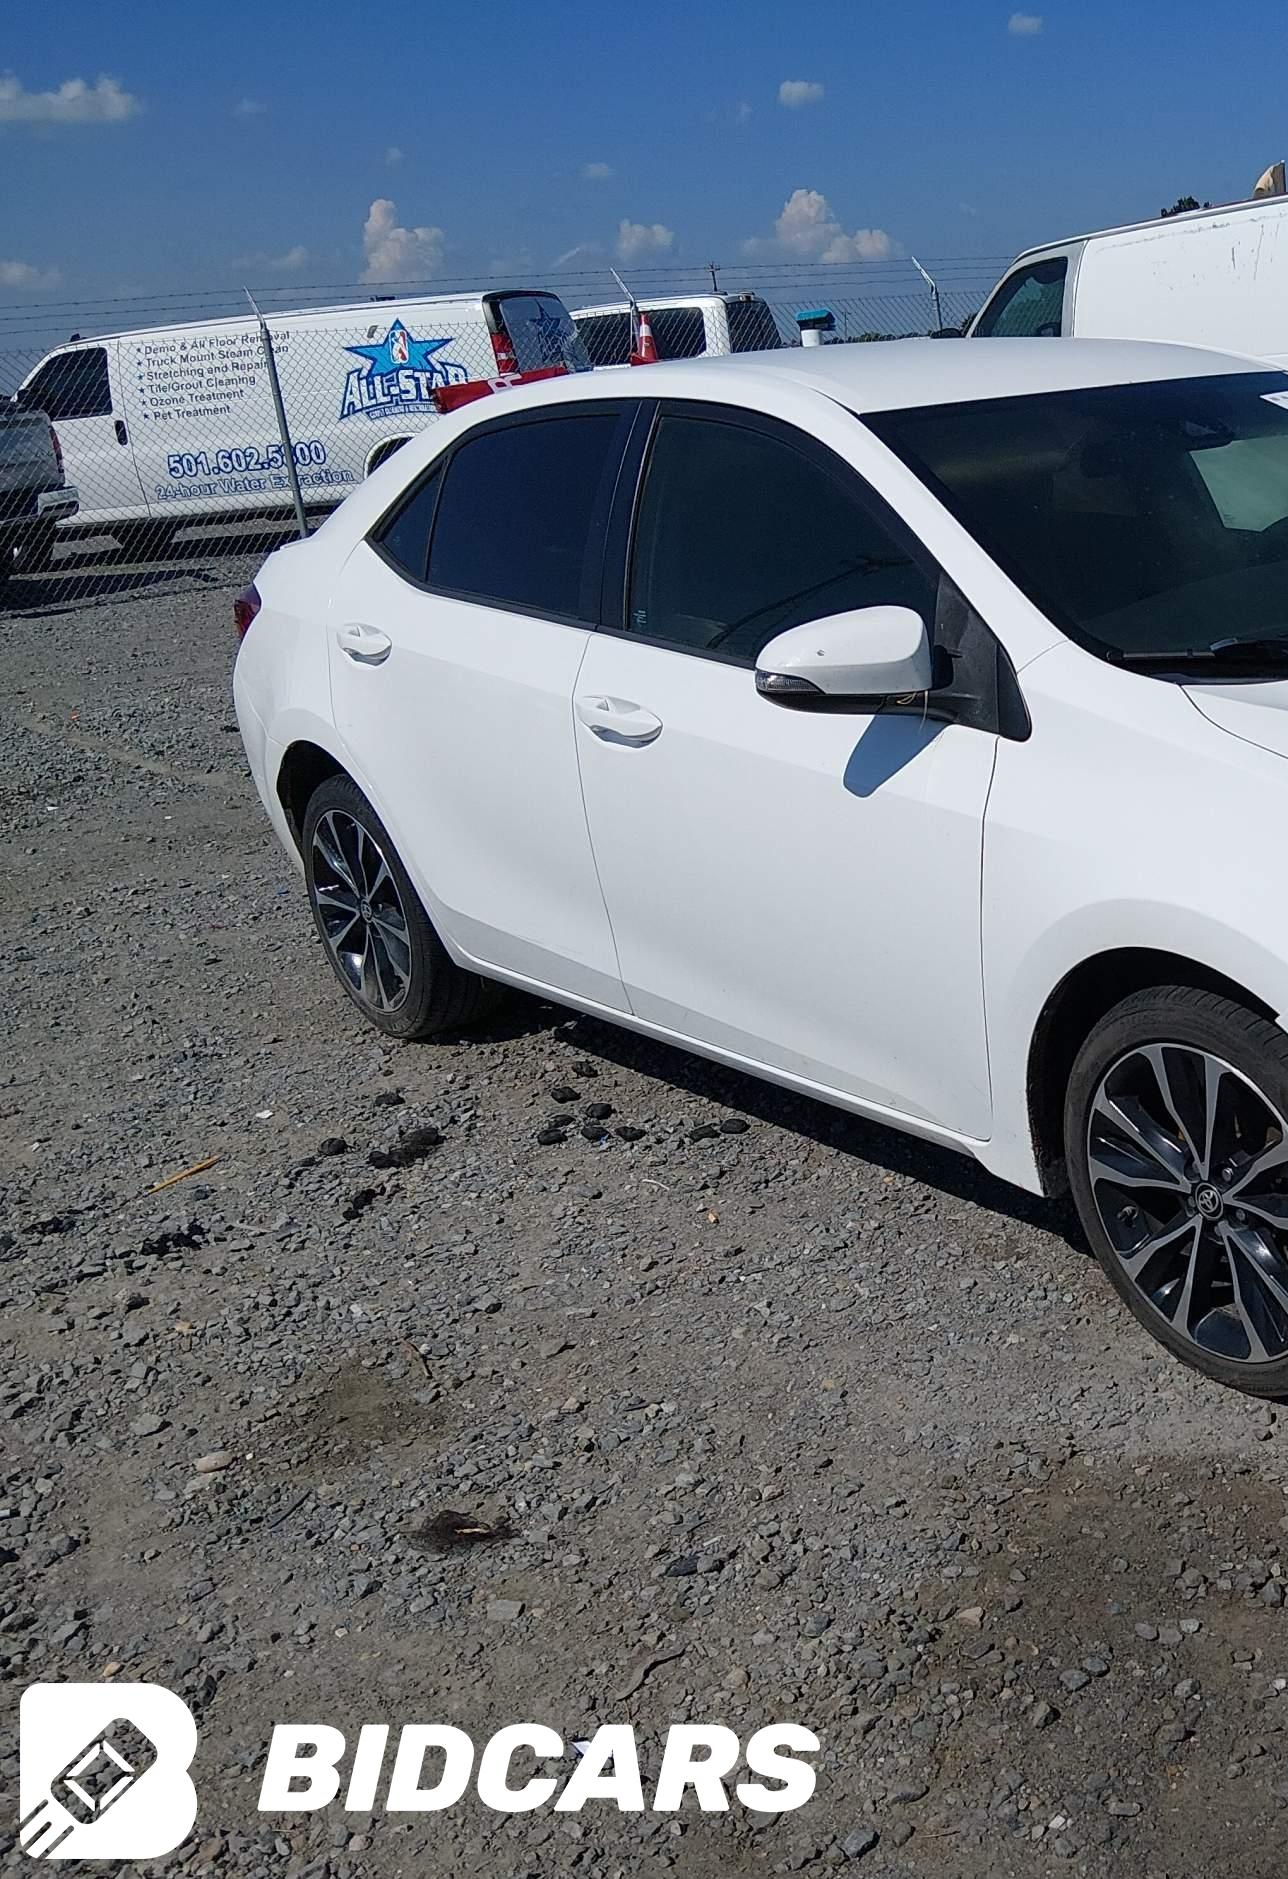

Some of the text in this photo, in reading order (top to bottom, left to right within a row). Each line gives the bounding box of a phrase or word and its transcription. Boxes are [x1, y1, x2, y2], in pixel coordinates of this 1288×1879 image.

[144, 344, 176, 355] Demo
[179, 342, 187, 351] &
[209, 336, 238, 348] Floor
[241, 331, 290, 345] Reval
[145, 344, 289, 368] Truck Mount Steam Can
[146, 358, 268, 381] Stretching and Repair
[149, 375, 256, 395] Tile/Grout Cleaning
[150, 388, 244, 407] Ozone Treatment
[154, 405, 232, 421] Pet Treatment
[155, 469, 355, 500] 24-hour Water Exraction
